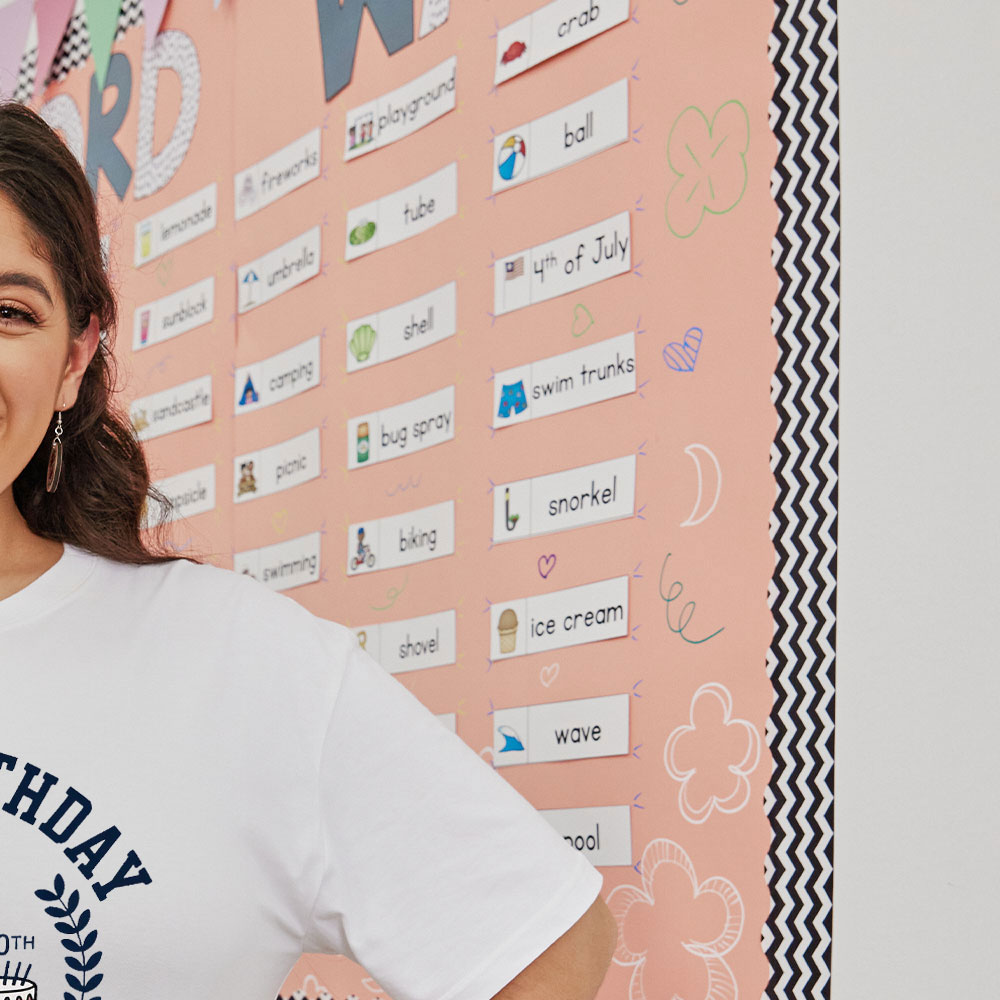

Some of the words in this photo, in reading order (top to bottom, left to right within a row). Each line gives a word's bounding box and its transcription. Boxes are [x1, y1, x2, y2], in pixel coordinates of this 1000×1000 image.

[557, 0, 600, 37] crab
[377, 66, 457, 137] playground
[564, 110, 594, 148] ball
[261, 147, 318, 194] fireworks
[160, 200, 213, 241] lemonade
[403, 194, 436, 225] tube
[266, 246, 315, 287] umbrella
[533, 251, 558, 283] 4th
[563, 243, 586, 275] of
[592, 230, 629, 265] July
[402, 306, 434, 340] shell
[268, 360, 314, 391] camping
[532, 375, 574, 400] swim
[580, 352, 635, 386] trunks
[380, 423, 408, 449] bug
[412, 410, 452, 442] spray
[275, 454, 308, 485] picnic
[548, 475, 617, 516] snorkel
[398, 527, 437, 554] biking
[263, 554, 318, 583] swimming
[530, 618, 556, 639] ice
[563, 603, 624, 632] cream
[398, 628, 440, 660] shovel
[554, 721, 602, 745] wave
